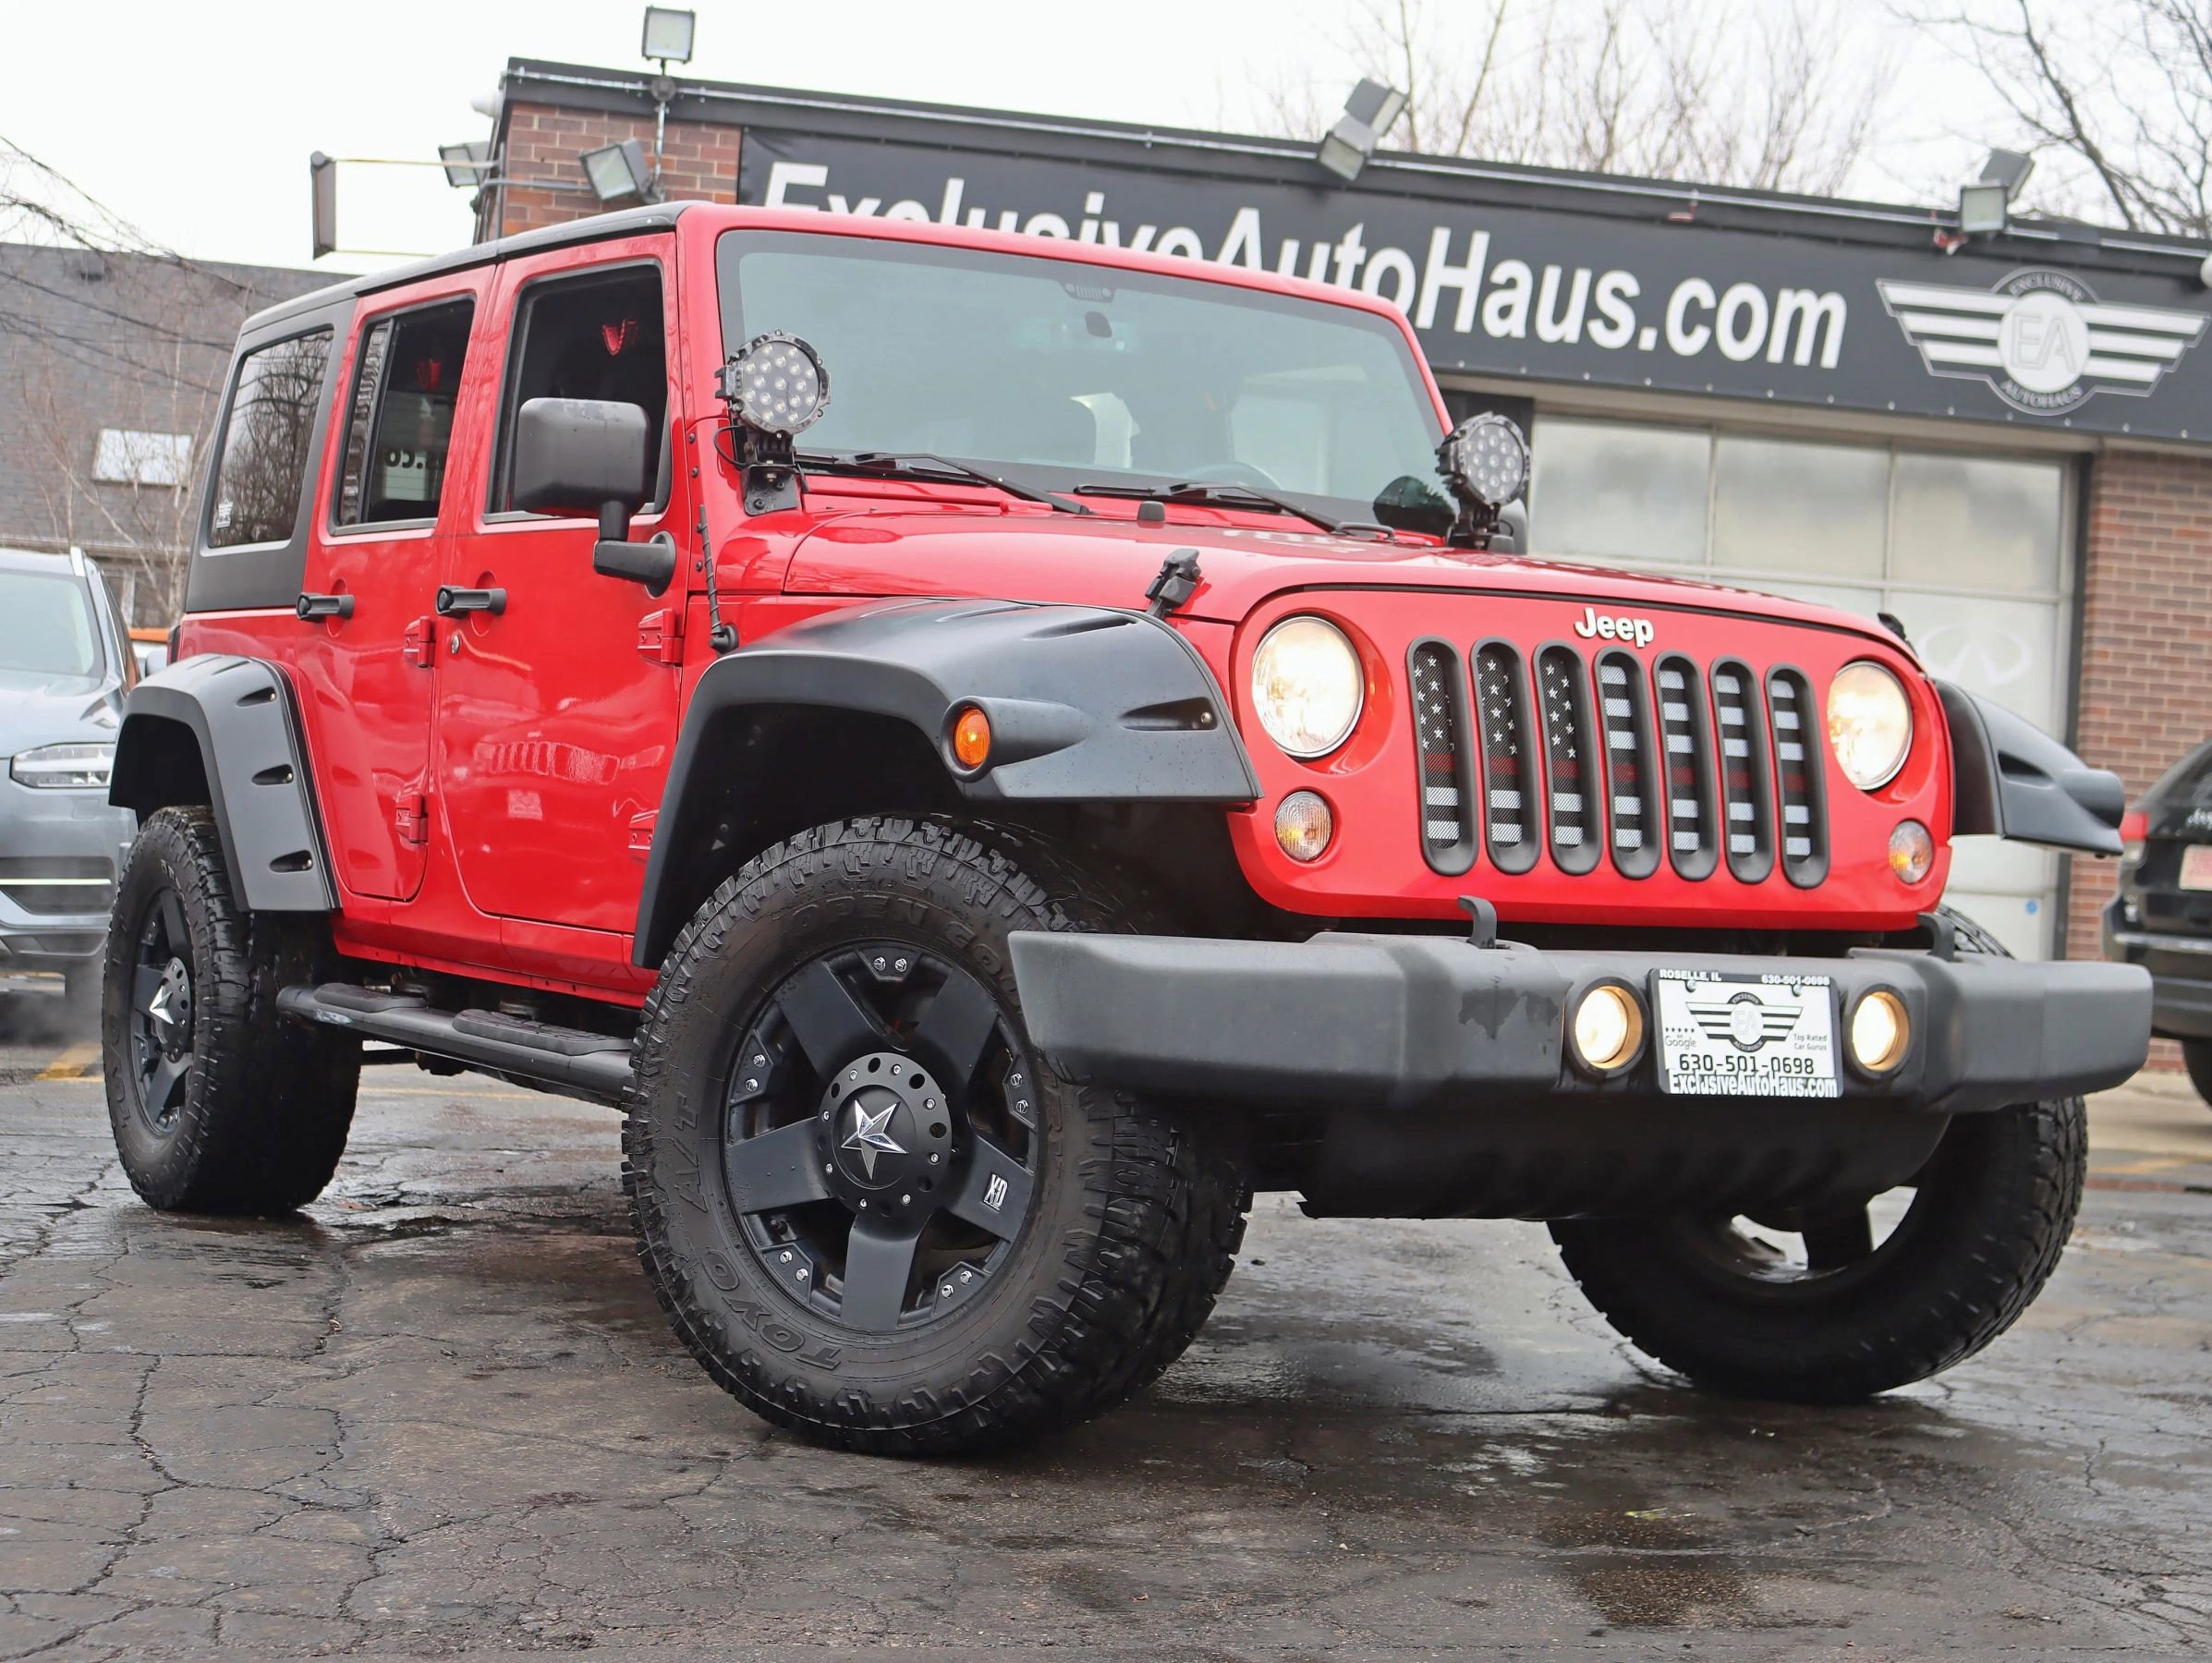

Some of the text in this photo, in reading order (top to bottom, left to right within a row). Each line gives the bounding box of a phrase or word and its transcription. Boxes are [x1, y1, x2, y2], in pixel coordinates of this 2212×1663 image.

[762, 162, 1847, 370] AutoHaus.com
[2008, 274, 2084, 301] EXCLUSIVE
[2013, 312, 2078, 374] EA
[2001, 381, 2083, 408] AUTOHAUS
[1574, 606, 1655, 649] Jeep
[1659, 969, 1721, 981] ROSELLE, IL
[1665, 1035, 1697, 1050] Google
[1679, 1053, 1815, 1074] 630-501-0698
[1670, 1069, 1839, 1098] ExclusiveAutoHaus.com
[701, 1248, 842, 1370] TOYO
